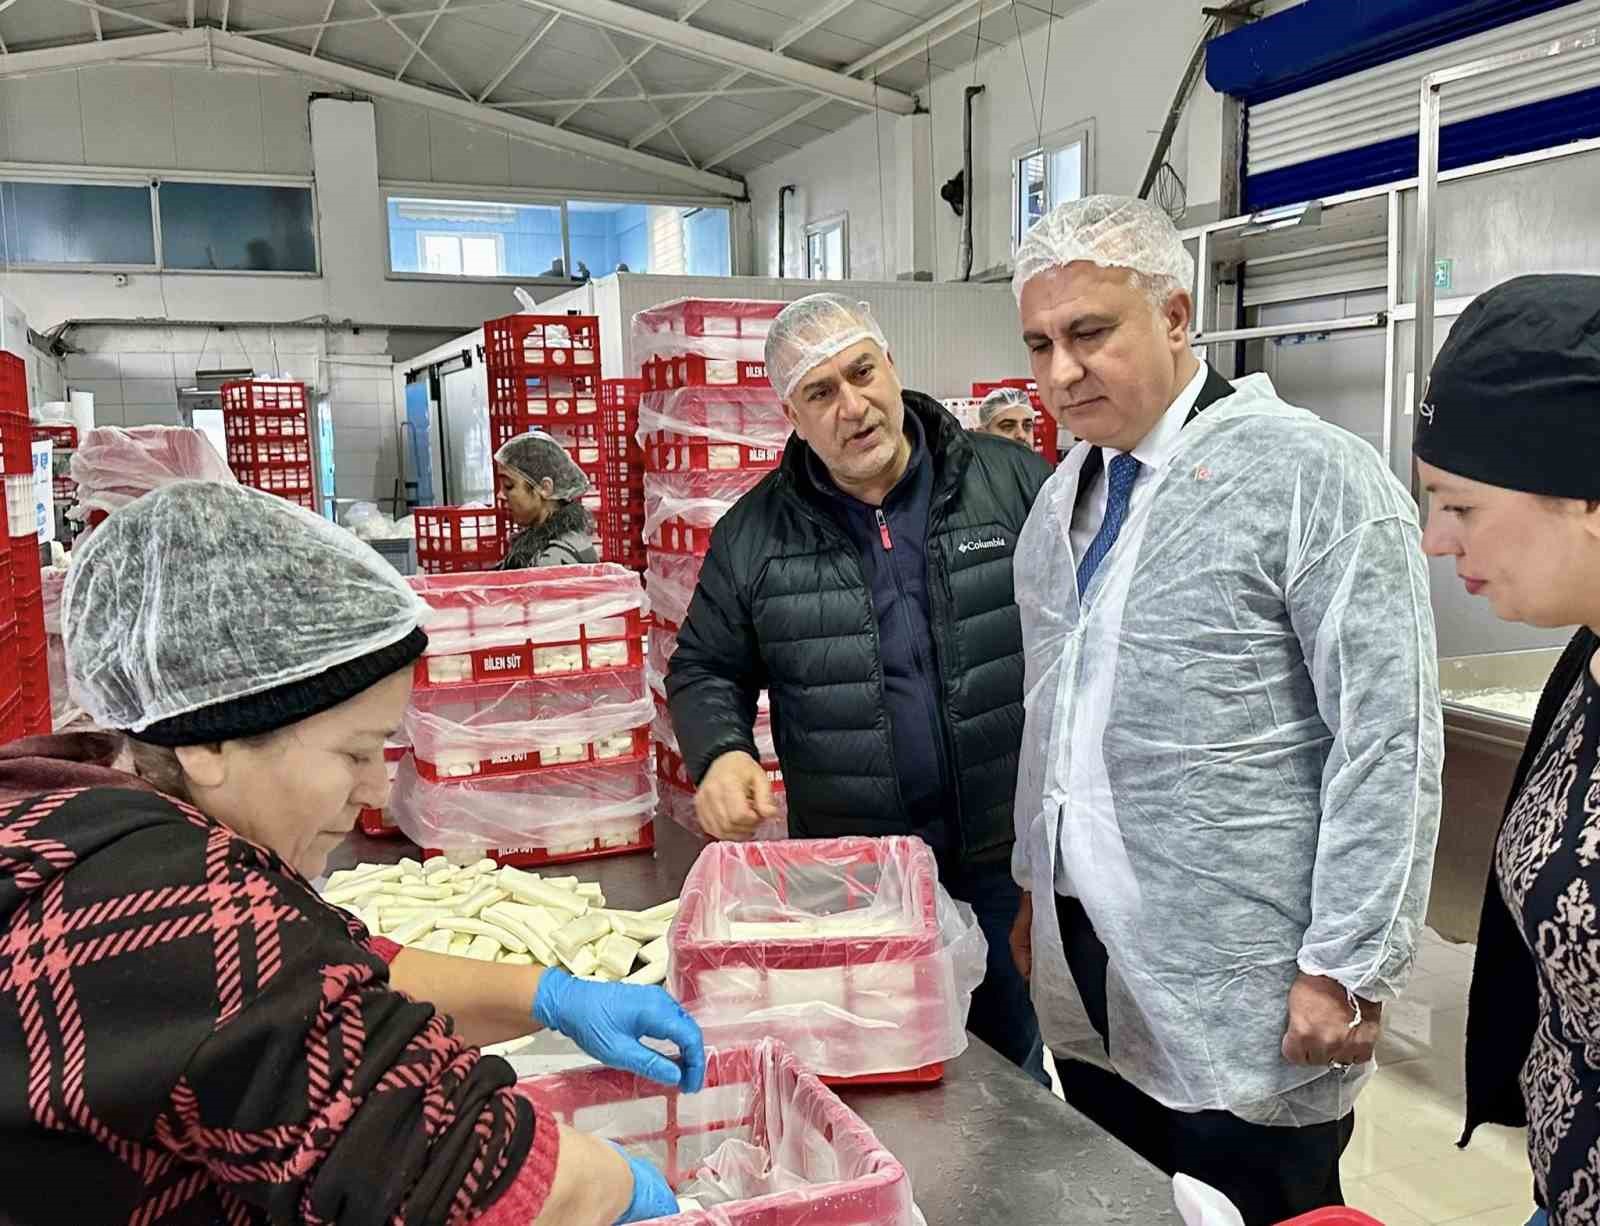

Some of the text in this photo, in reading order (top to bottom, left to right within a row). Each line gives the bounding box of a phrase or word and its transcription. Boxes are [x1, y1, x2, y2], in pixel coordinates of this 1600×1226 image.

[967, 537, 1006, 550] Columbia
[484, 653, 521, 671] BİLEN SÜT
